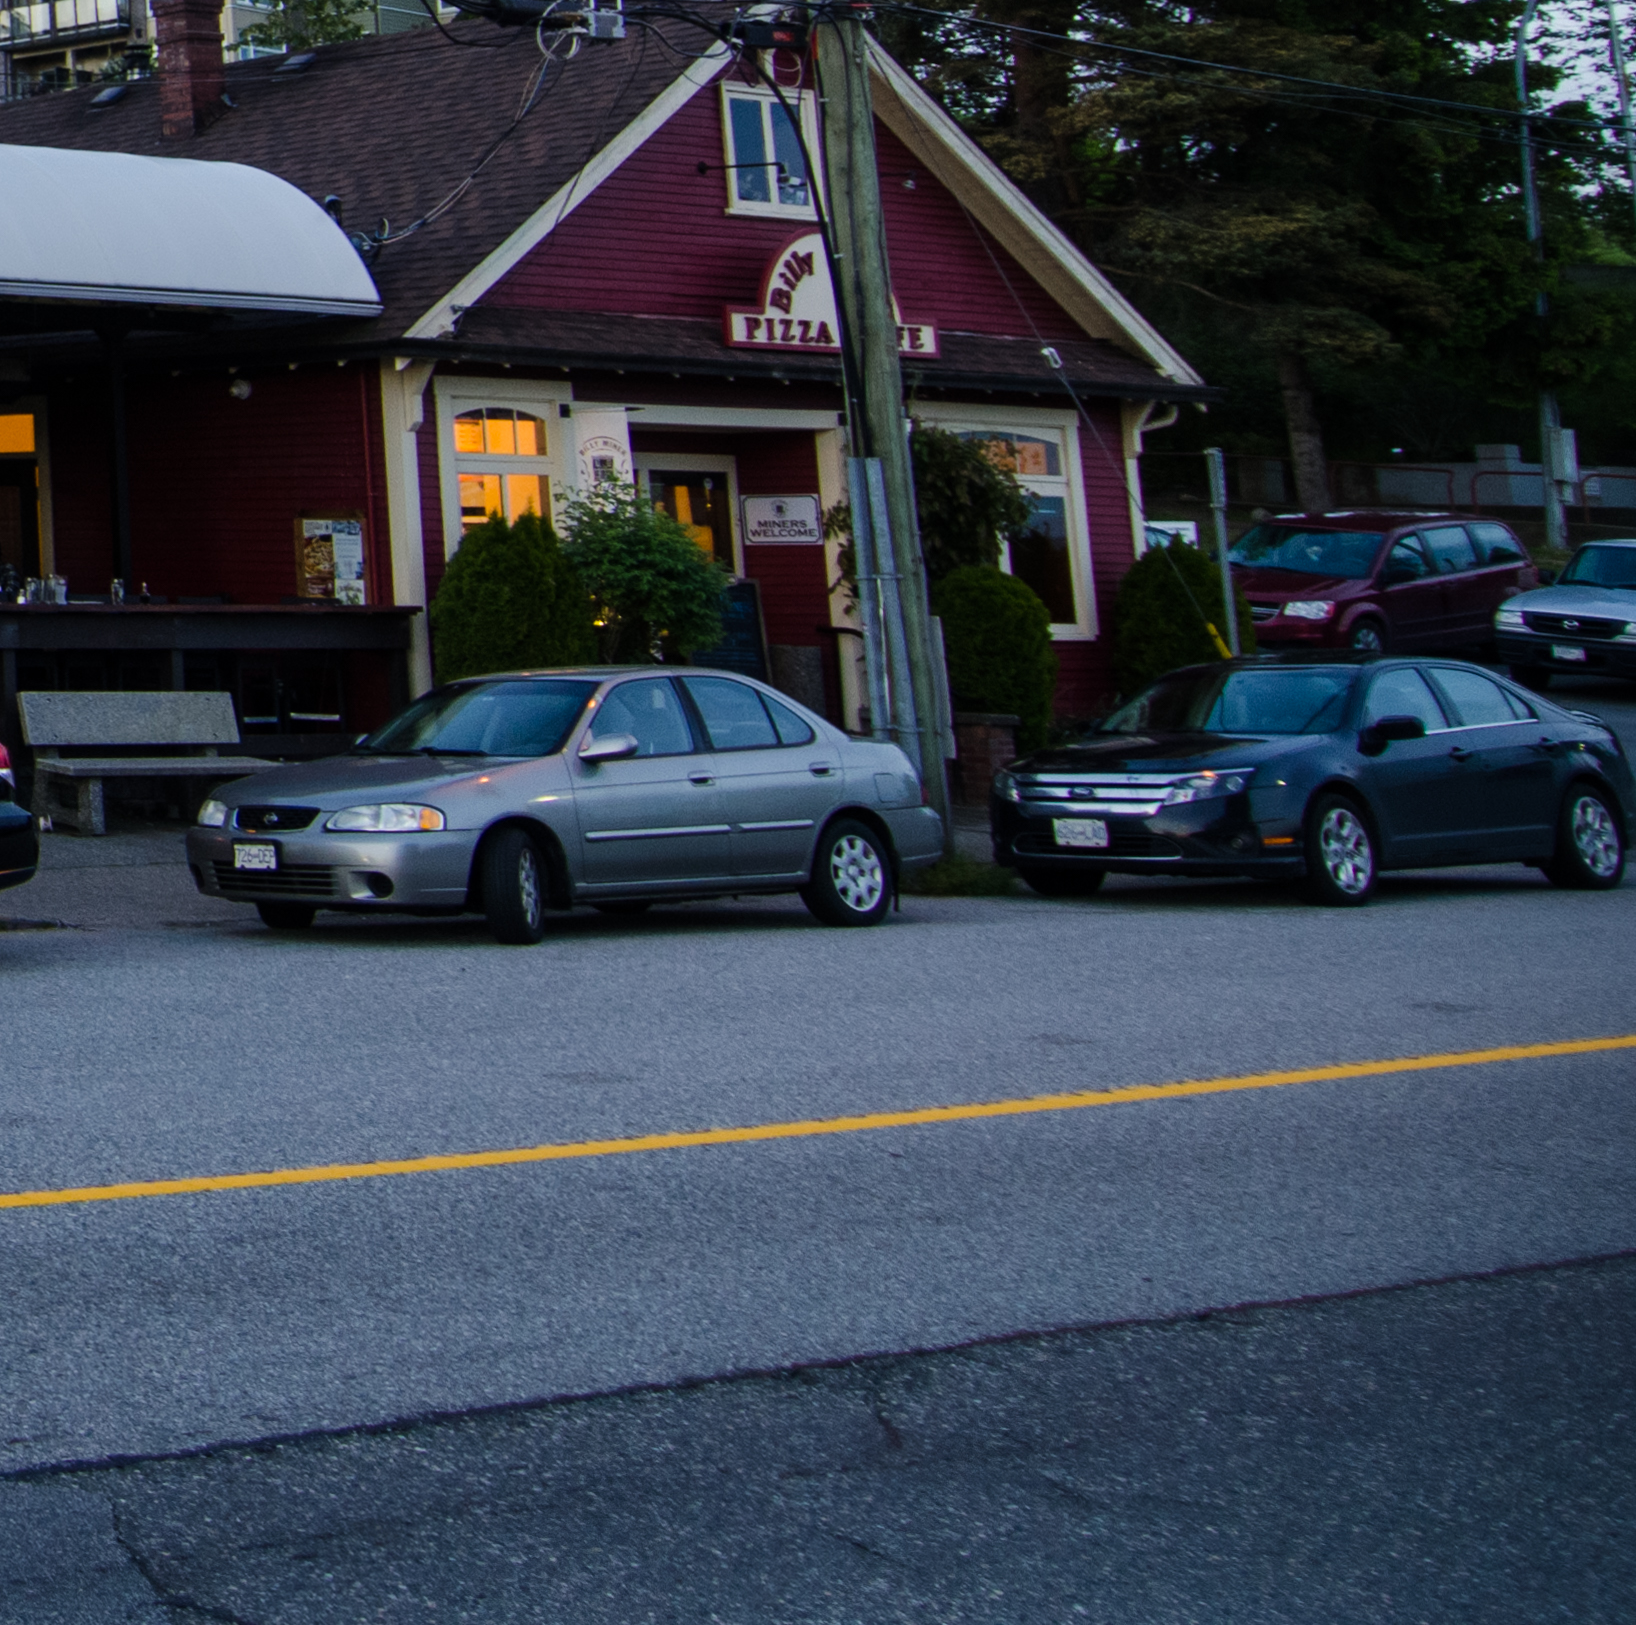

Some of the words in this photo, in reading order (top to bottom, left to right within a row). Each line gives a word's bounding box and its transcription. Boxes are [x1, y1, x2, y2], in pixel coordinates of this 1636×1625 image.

[769, 250, 815, 314] Billy
[744, 316, 835, 345] PIZZA
[750, 528, 817, 537] WELCOME
[757, 520, 807, 528] MINERS
